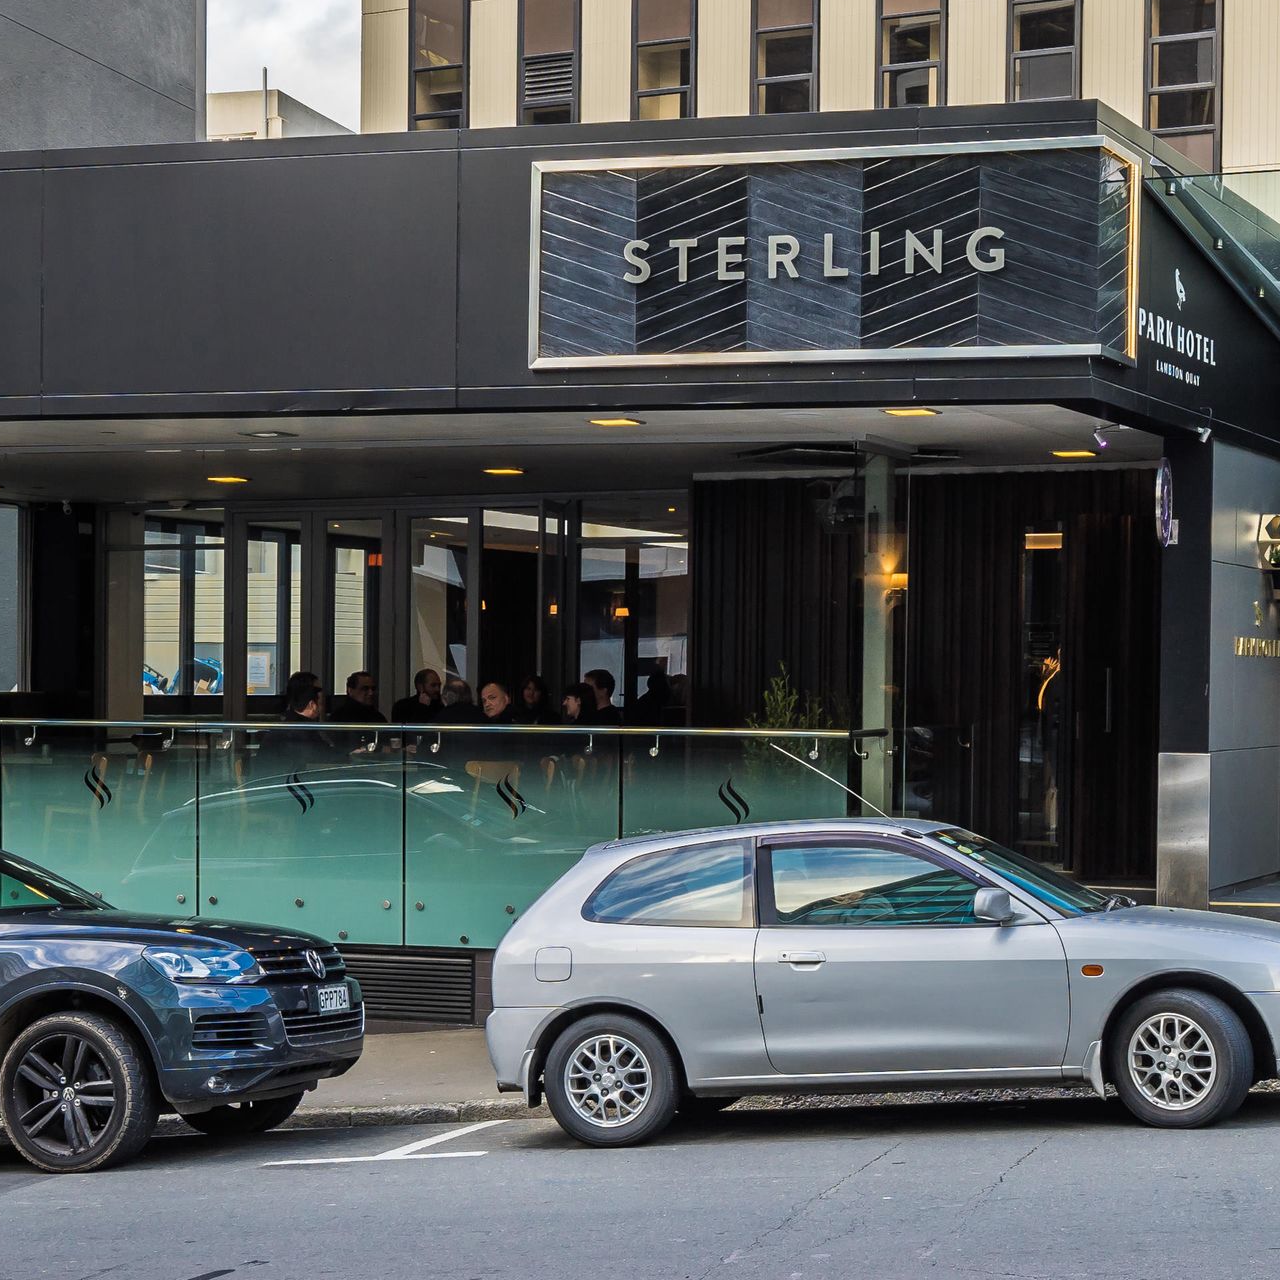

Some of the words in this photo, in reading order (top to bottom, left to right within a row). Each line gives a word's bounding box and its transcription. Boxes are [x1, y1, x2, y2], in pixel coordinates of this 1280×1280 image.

[622, 226, 1007, 285] STERLING
[1138, 307, 1174, 349] PARK
[1177, 324, 1216, 366] HOTEL
[319, 989, 347, 1009] GPP784
